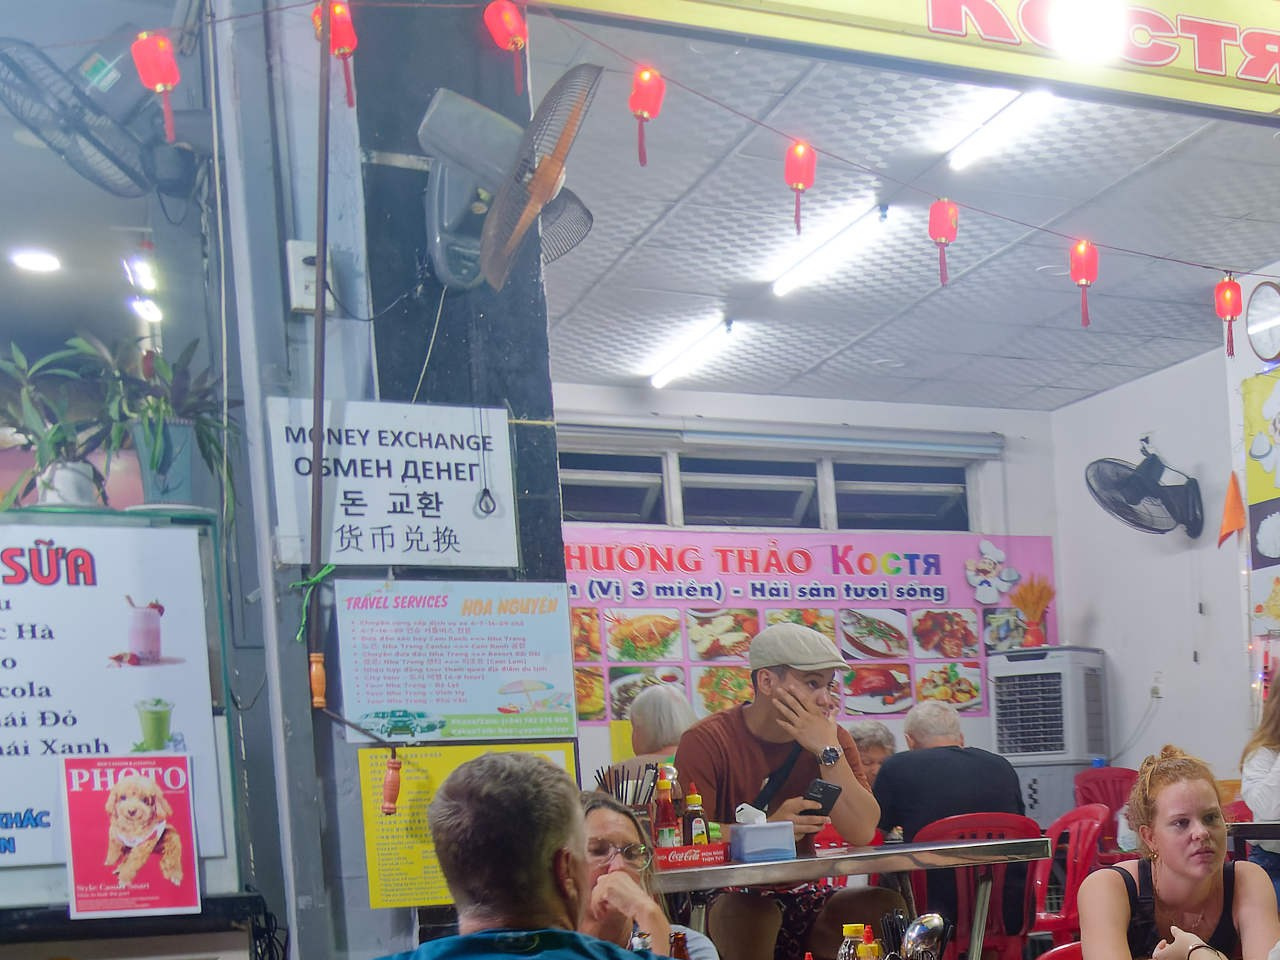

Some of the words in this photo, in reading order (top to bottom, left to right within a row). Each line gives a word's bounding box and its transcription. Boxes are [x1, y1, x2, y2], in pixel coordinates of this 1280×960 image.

[378, 429, 495, 451] EXCHANGE
[401, 460, 480, 484] ДЕНЕГ
[340, 490, 368, 516] 돈
[387, 491, 444, 519] 교환
[335, 524, 462, 554] 货币兑换
[0, 539, 97, 586] SỮA
[714, 538, 813, 575] THẢO
[588, 580, 621, 599] (Vị
[630, 581, 645, 597] 3
[346, 596, 389, 610] TRAVEL
[392, 594, 448, 609] SERVICES
[16, 623, 55, 640] Hà
[39, 709, 78, 727] Đỏ
[40, 737, 110, 755] Xanh
